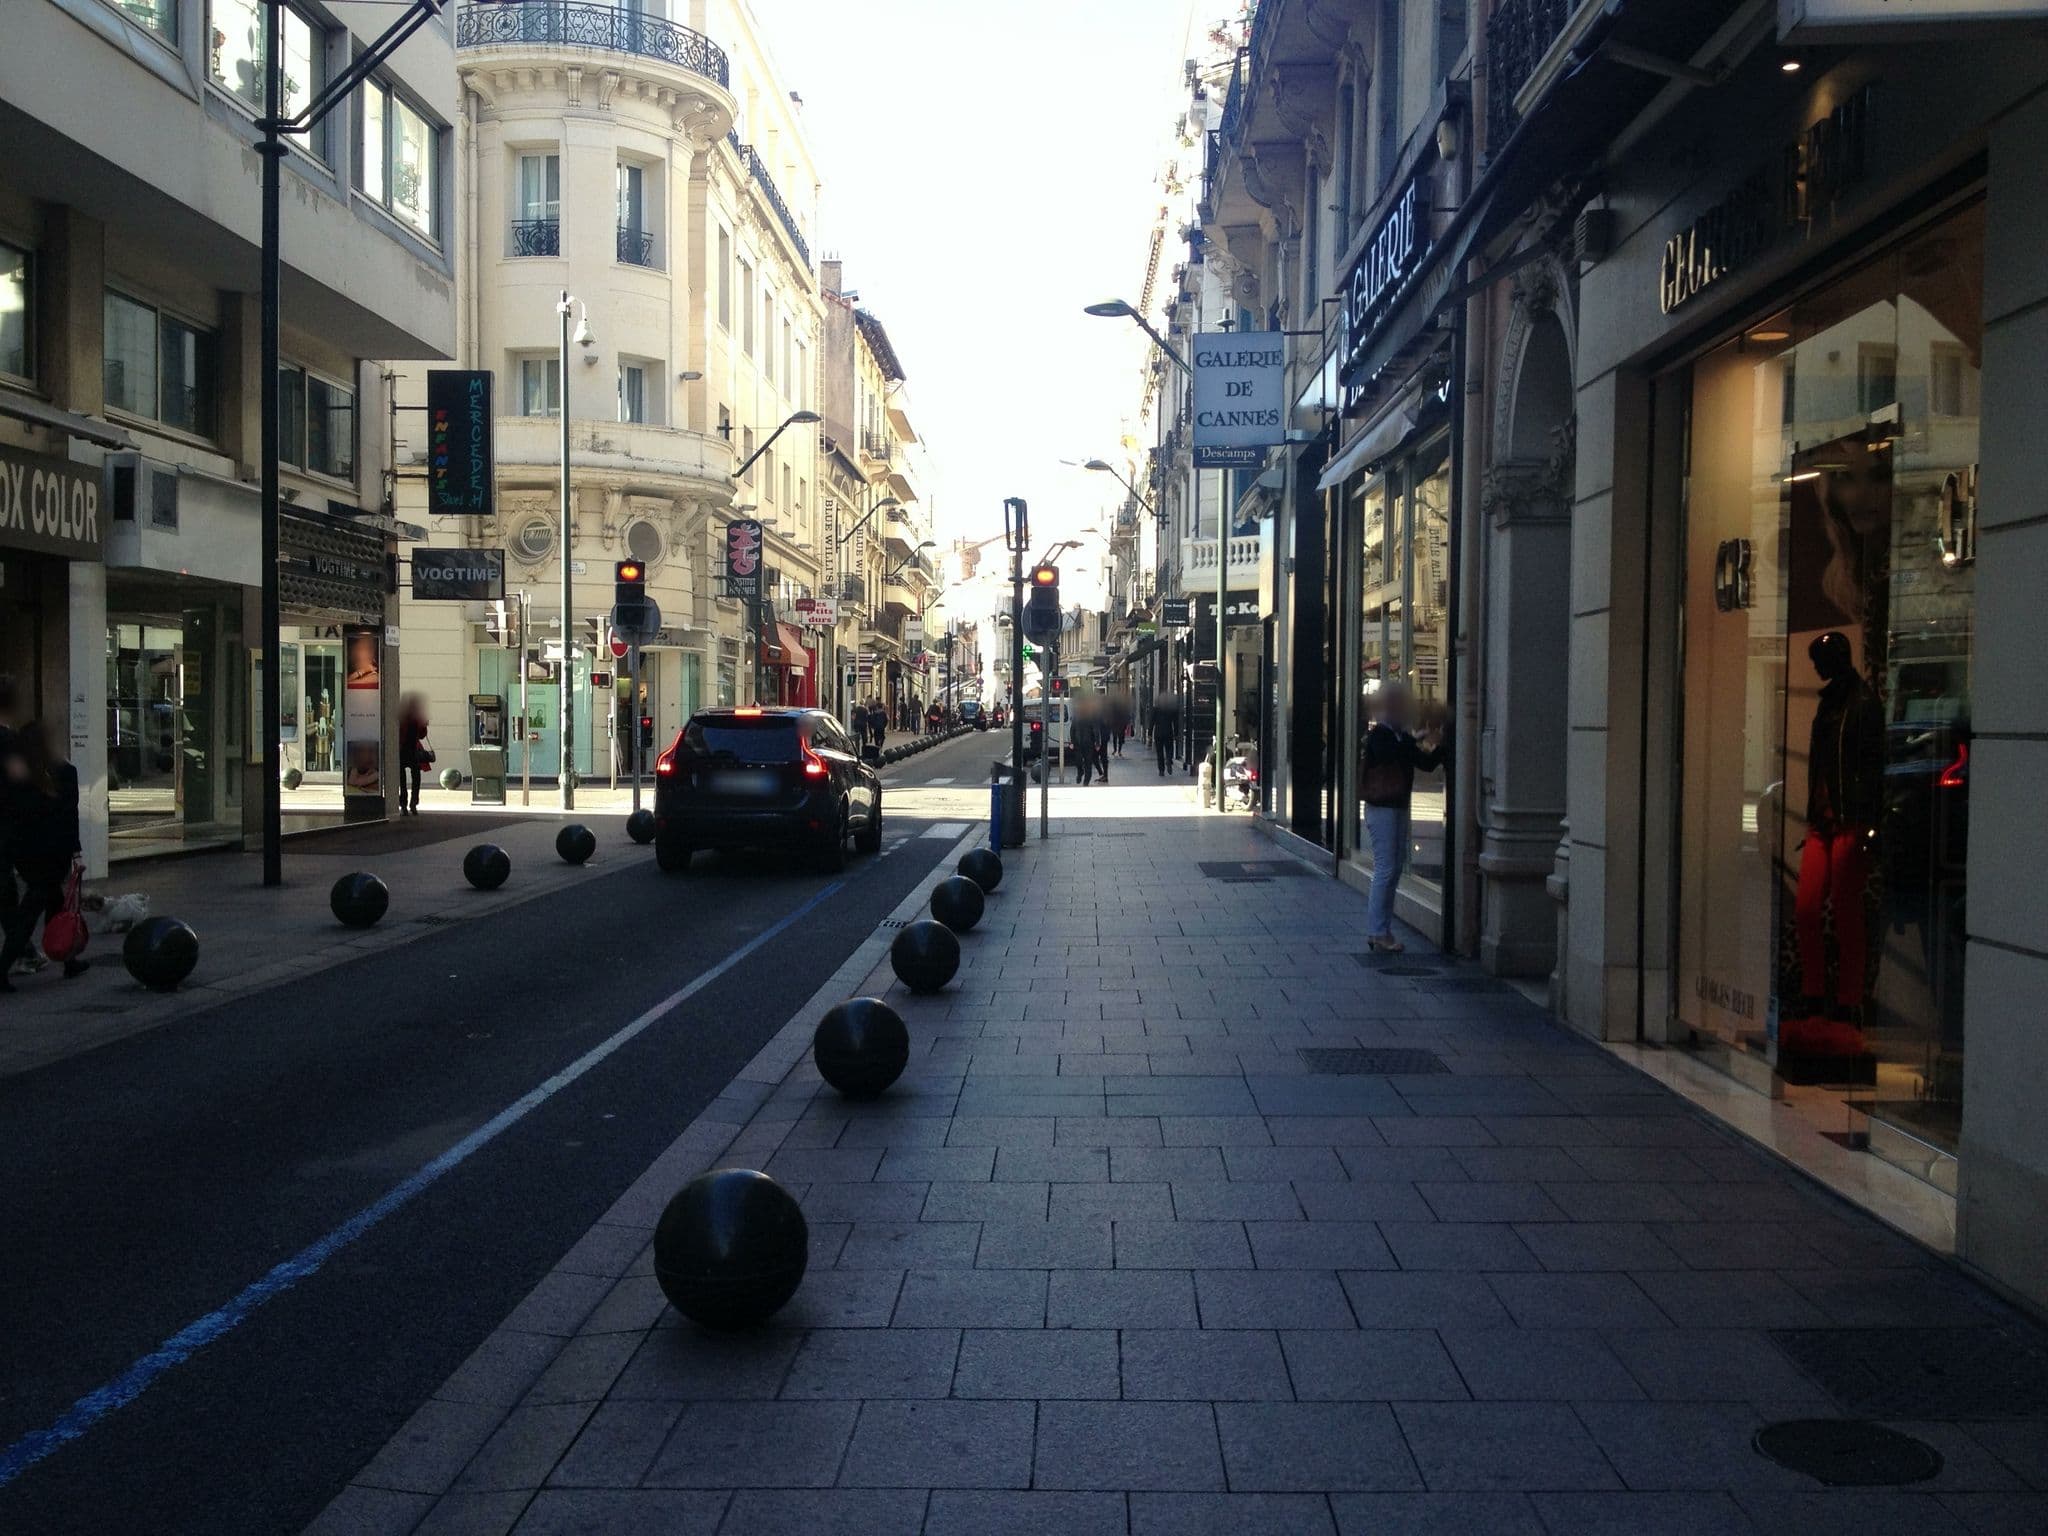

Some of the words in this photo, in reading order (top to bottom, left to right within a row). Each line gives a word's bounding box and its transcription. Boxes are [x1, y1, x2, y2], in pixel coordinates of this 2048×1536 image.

[1352, 177, 1416, 329] GALERIE
[1196, 349, 1283, 369] GALERIE
[1225, 380, 1253, 397] DE
[1197, 408, 1280, 428] CANNES
[1202, 446, 1256, 461] Descamps
[31, 468, 98, 543] COLOR
[825, 499, 834, 532] BLUE
[315, 557, 357, 579] VOGTIME
[417, 567, 500, 581] VOGTIME
[1208, 604, 1236, 616] Te
